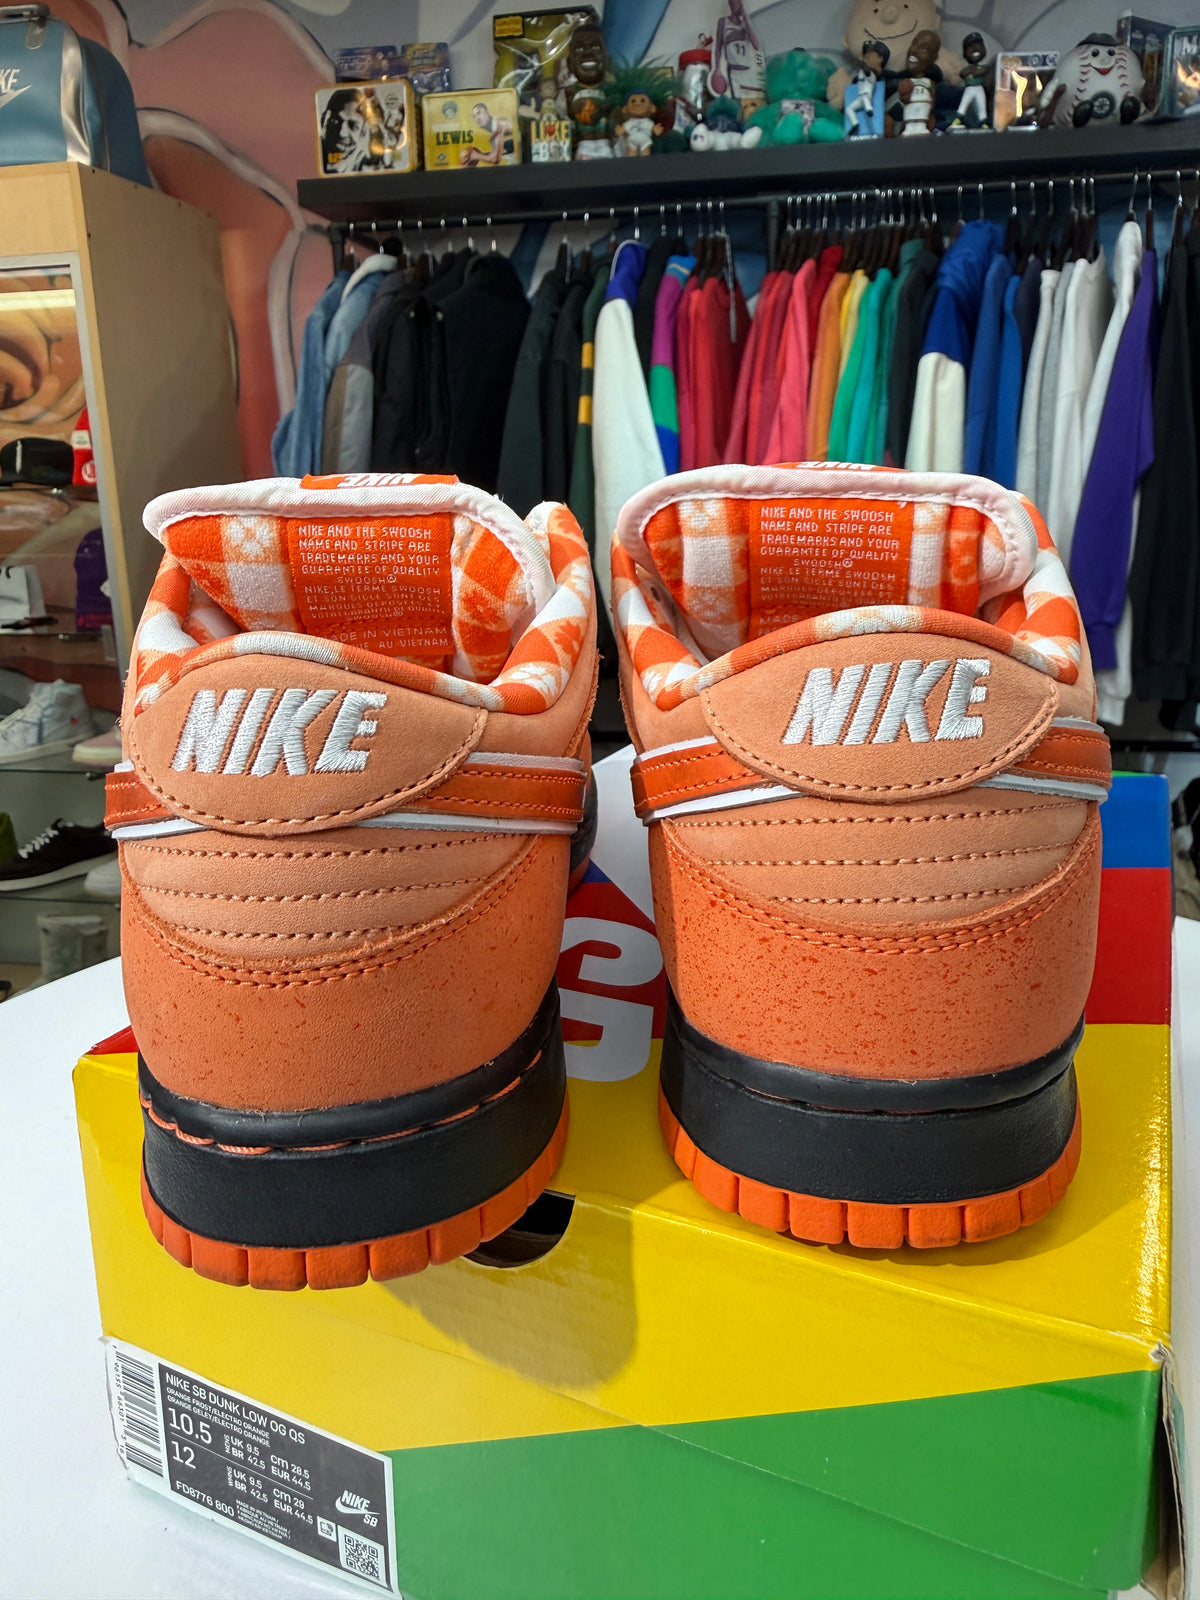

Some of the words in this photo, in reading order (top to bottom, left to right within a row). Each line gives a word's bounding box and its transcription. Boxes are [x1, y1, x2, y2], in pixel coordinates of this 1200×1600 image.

[436, 130, 474, 146] LEWIS
[761, 507, 786, 520] NIKE
[789, 507, 812, 519] AND
[817, 509, 838, 520] THE
[843, 510, 894, 522] SWOOSH
[299, 525, 323, 537] NIKE
[327, 526, 350, 537] AND
[356, 527, 376, 537] THE
[381, 527, 431, 539] SWOOSH
[760, 521, 791, 532] NAME
[795, 521, 818, 532] AND
[825, 523, 865, 534] STRIPE
[868, 525, 892, 536] ARE
[299, 538, 330, 550] NAME
[335, 539, 357, 550] AND
[365, 540, 403, 551] STRIPE
[408, 541, 430, 552] ARE
[760, 534, 837, 546] TRADEMARKS
[839, 536, 863, 547] AND
[867, 538, 899, 550] YOUR
[300, 552, 376, 564] TRADEMARKS
[381, 552, 404, 564] AND
[408, 554, 440, 565] YOUR
[760, 546, 827, 557] GUARANTEE
[831, 549, 845, 558] OF
[850, 550, 899, 561] QUALITY
[302, 565, 370, 575] GUARANTEE
[375, 565, 387, 574] OF
[393, 566, 440, 576] QUALITY
[392, 586, 440, 594] SWOOSH
[363, 630, 377, 638] IN
[383, 627, 447, 637] VIETNAM
[380, 641, 393, 649] AU
[400, 639, 448, 647] VIETNAM
[781, 658, 991, 746] NIKE
[170, 688, 388, 777] NIKE
[165, 1372, 191, 1393] NIKE
[192, 1384, 207, 1401] SB
[208, 1391, 241, 1416] DUNK
[242, 1407, 268, 1428] LOW
[270, 1419, 287, 1437] OG
[289, 1427, 305, 1446] QS
[167, 1386, 191, 1403] ORANGE
[243, 1421, 270, 1439] ORANGE
[167, 1395, 192, 1411] ORANGE
[244, 1430, 270, 1447] ORANGE
[168, 1406, 213, 1446] 10.5
[171, 1439, 196, 1470] 12
[231, 1436, 244, 1449] UK
[246, 1443, 260, 1457] 9.5
[232, 1447, 244, 1460] BR
[247, 1454, 266, 1470] 42.5
[233, 1469, 247, 1483] UK
[249, 1476, 263, 1490] 9.5
[271, 1465, 290, 1481] EUR
[292, 1475, 311, 1491] 44.5
[291, 1463, 310, 1480] 28.5
[176, 1480, 213, 1506] FD8776
[215, 1499, 234, 1517] 800
[234, 1480, 247, 1494] BR
[250, 1487, 268, 1503] 42.5
[341, 1490, 370, 1511] NIKE
[274, 1499, 293, 1515] EUR
[294, 1508, 314, 1525] 44.5
[294, 1497, 305, 1510] 29
[363, 1514, 378, 1527] SB
